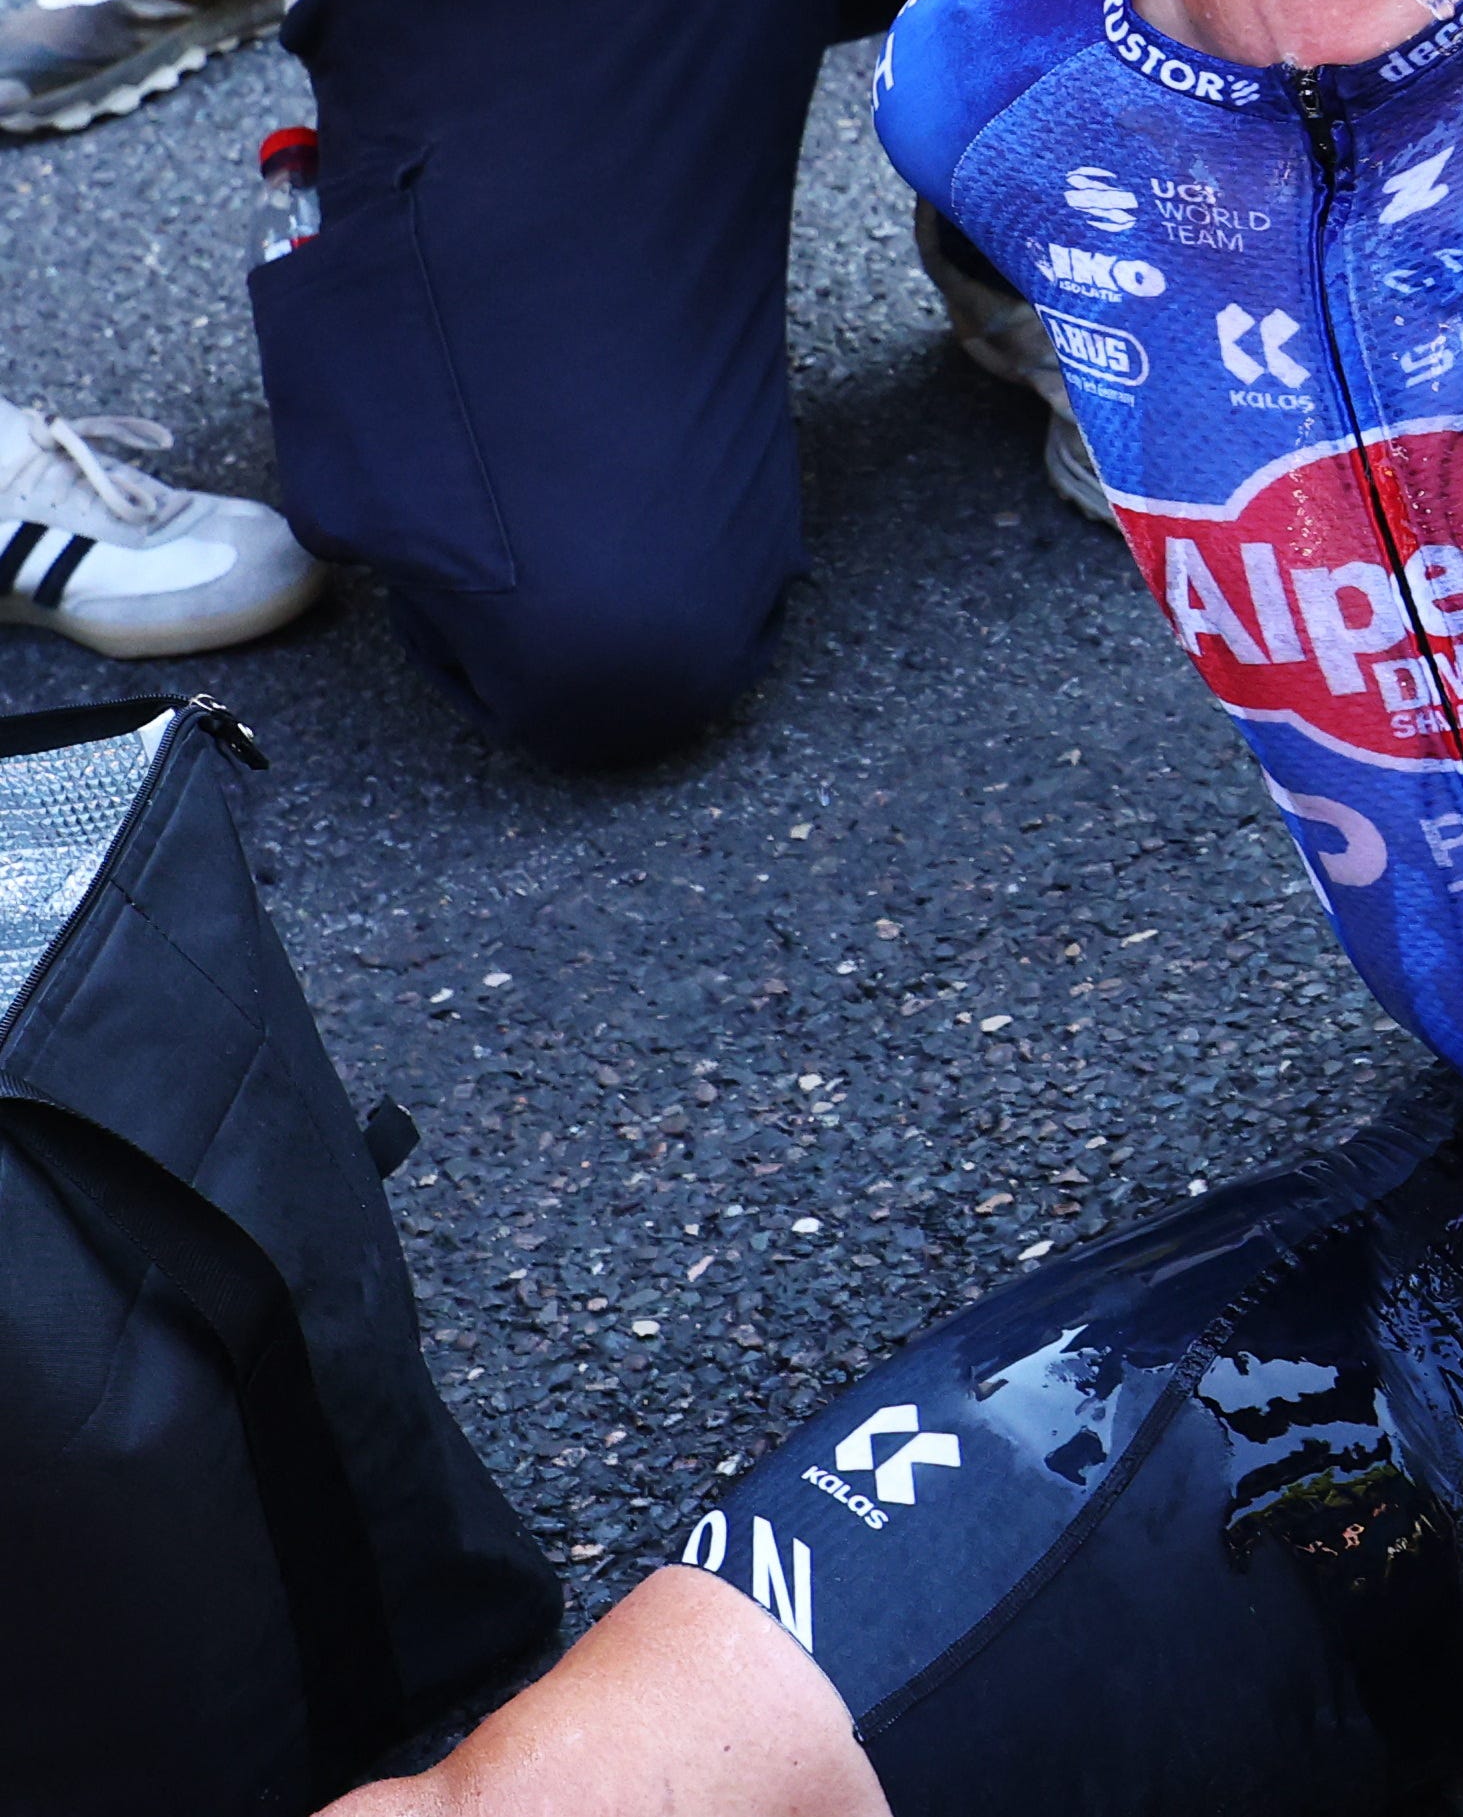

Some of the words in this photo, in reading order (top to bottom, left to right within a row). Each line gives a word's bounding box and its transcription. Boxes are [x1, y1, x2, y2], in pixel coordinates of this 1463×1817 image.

[1154, 199, 1271, 231] WORLD
[1160, 221, 1245, 253] TEAM
[1047, 317, 1131, 373] ABUS
